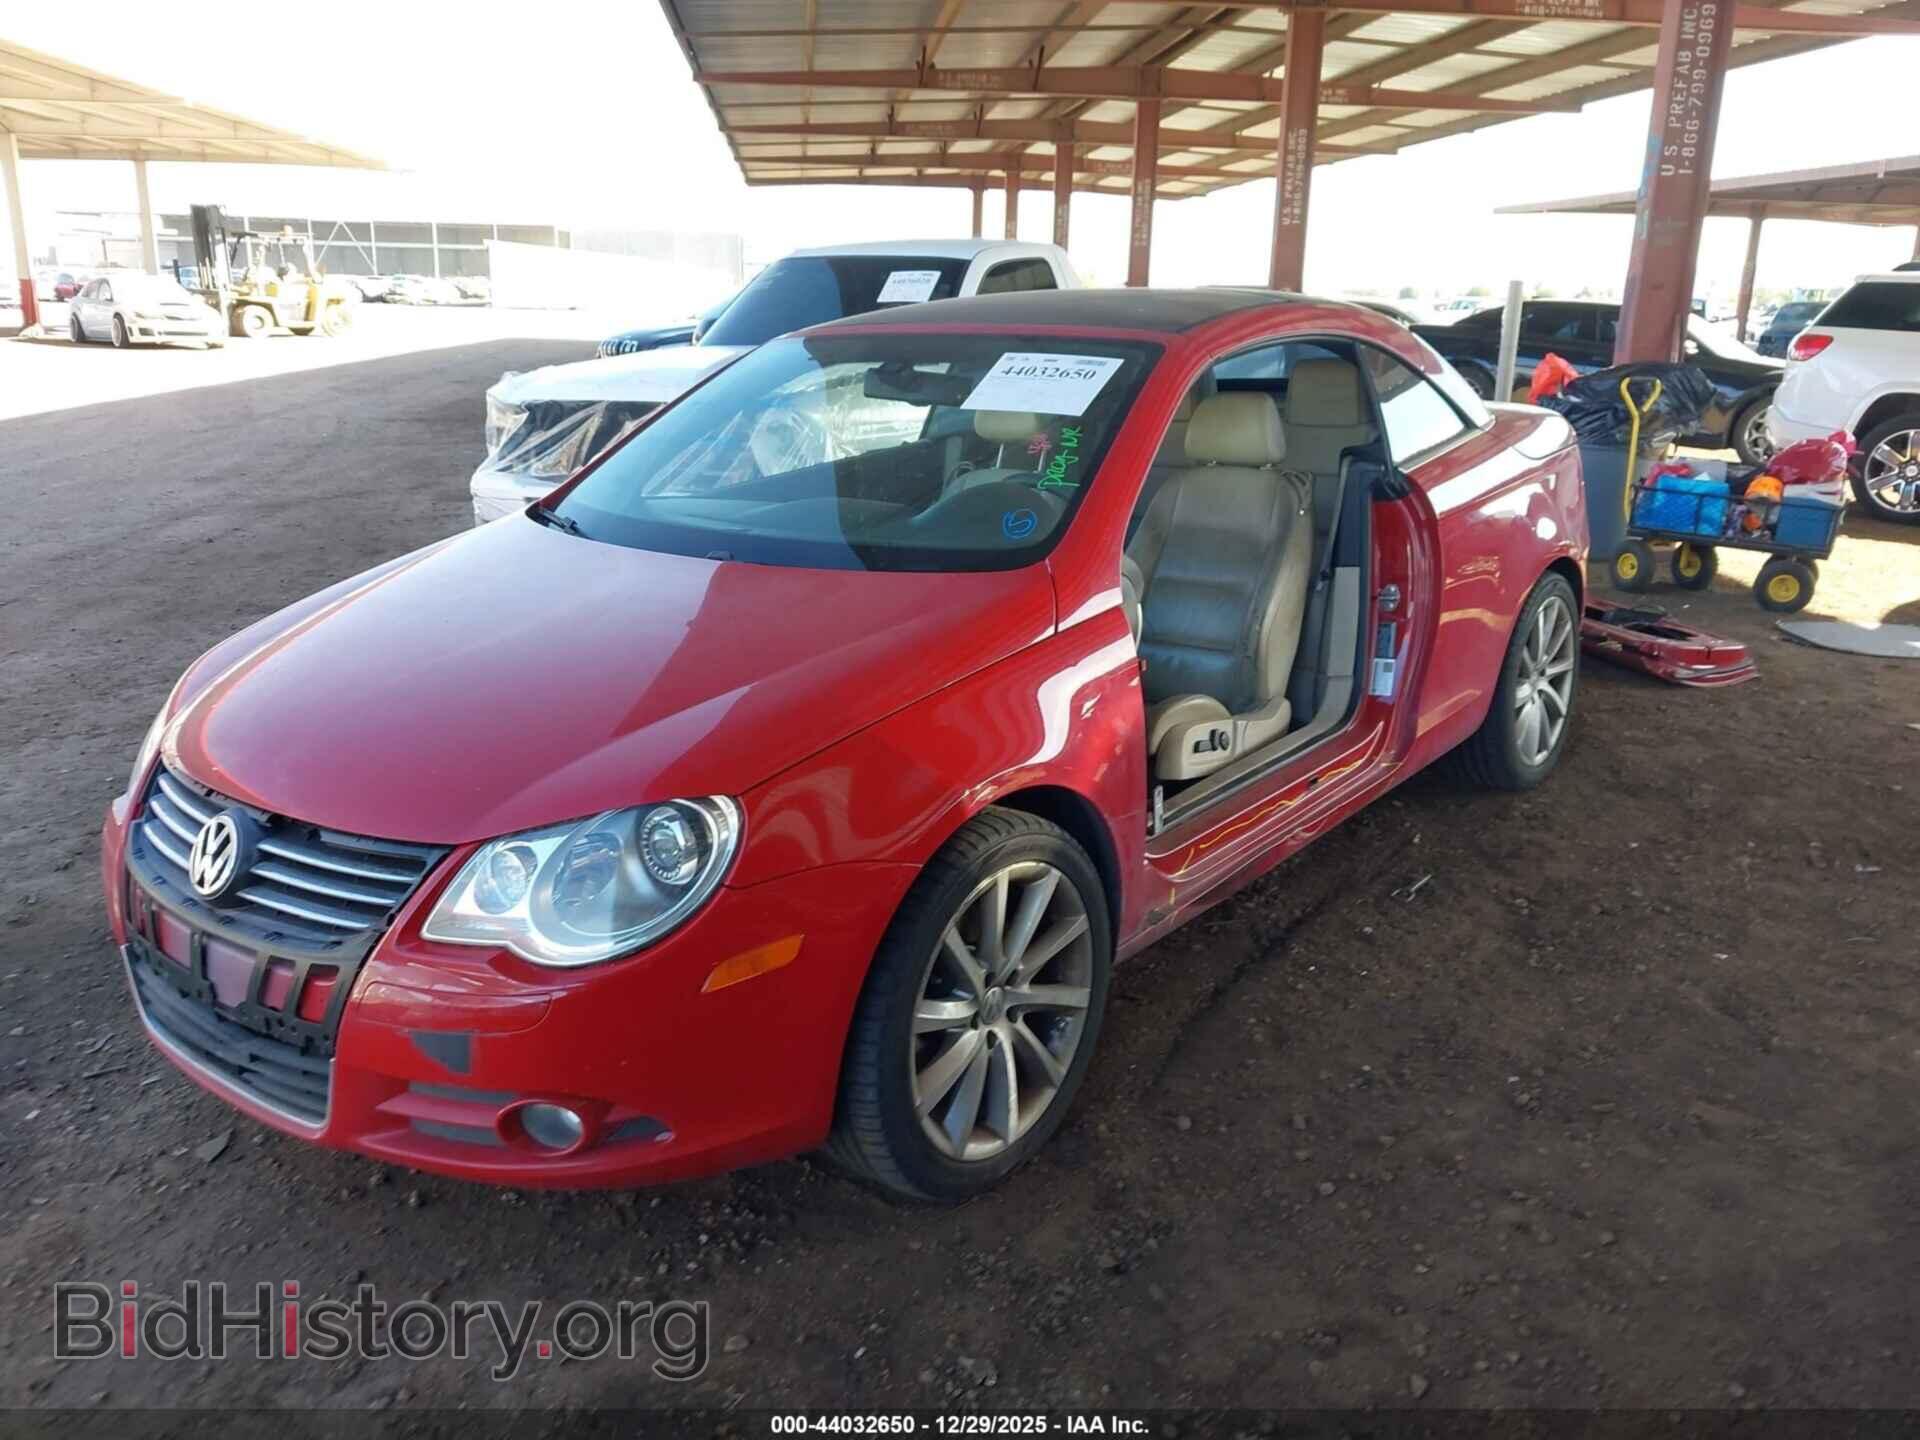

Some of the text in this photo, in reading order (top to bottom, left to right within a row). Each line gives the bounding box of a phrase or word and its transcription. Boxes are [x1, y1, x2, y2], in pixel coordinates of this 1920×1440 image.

[1668, 50, 1692, 127] PREFAB
[1681, 1, 1699, 39] INC.
[1678, 3, 1716, 174] 1-866-799-0969
[1001, 365, 1097, 380] 44032650
[188, 814, 239, 900] VW
